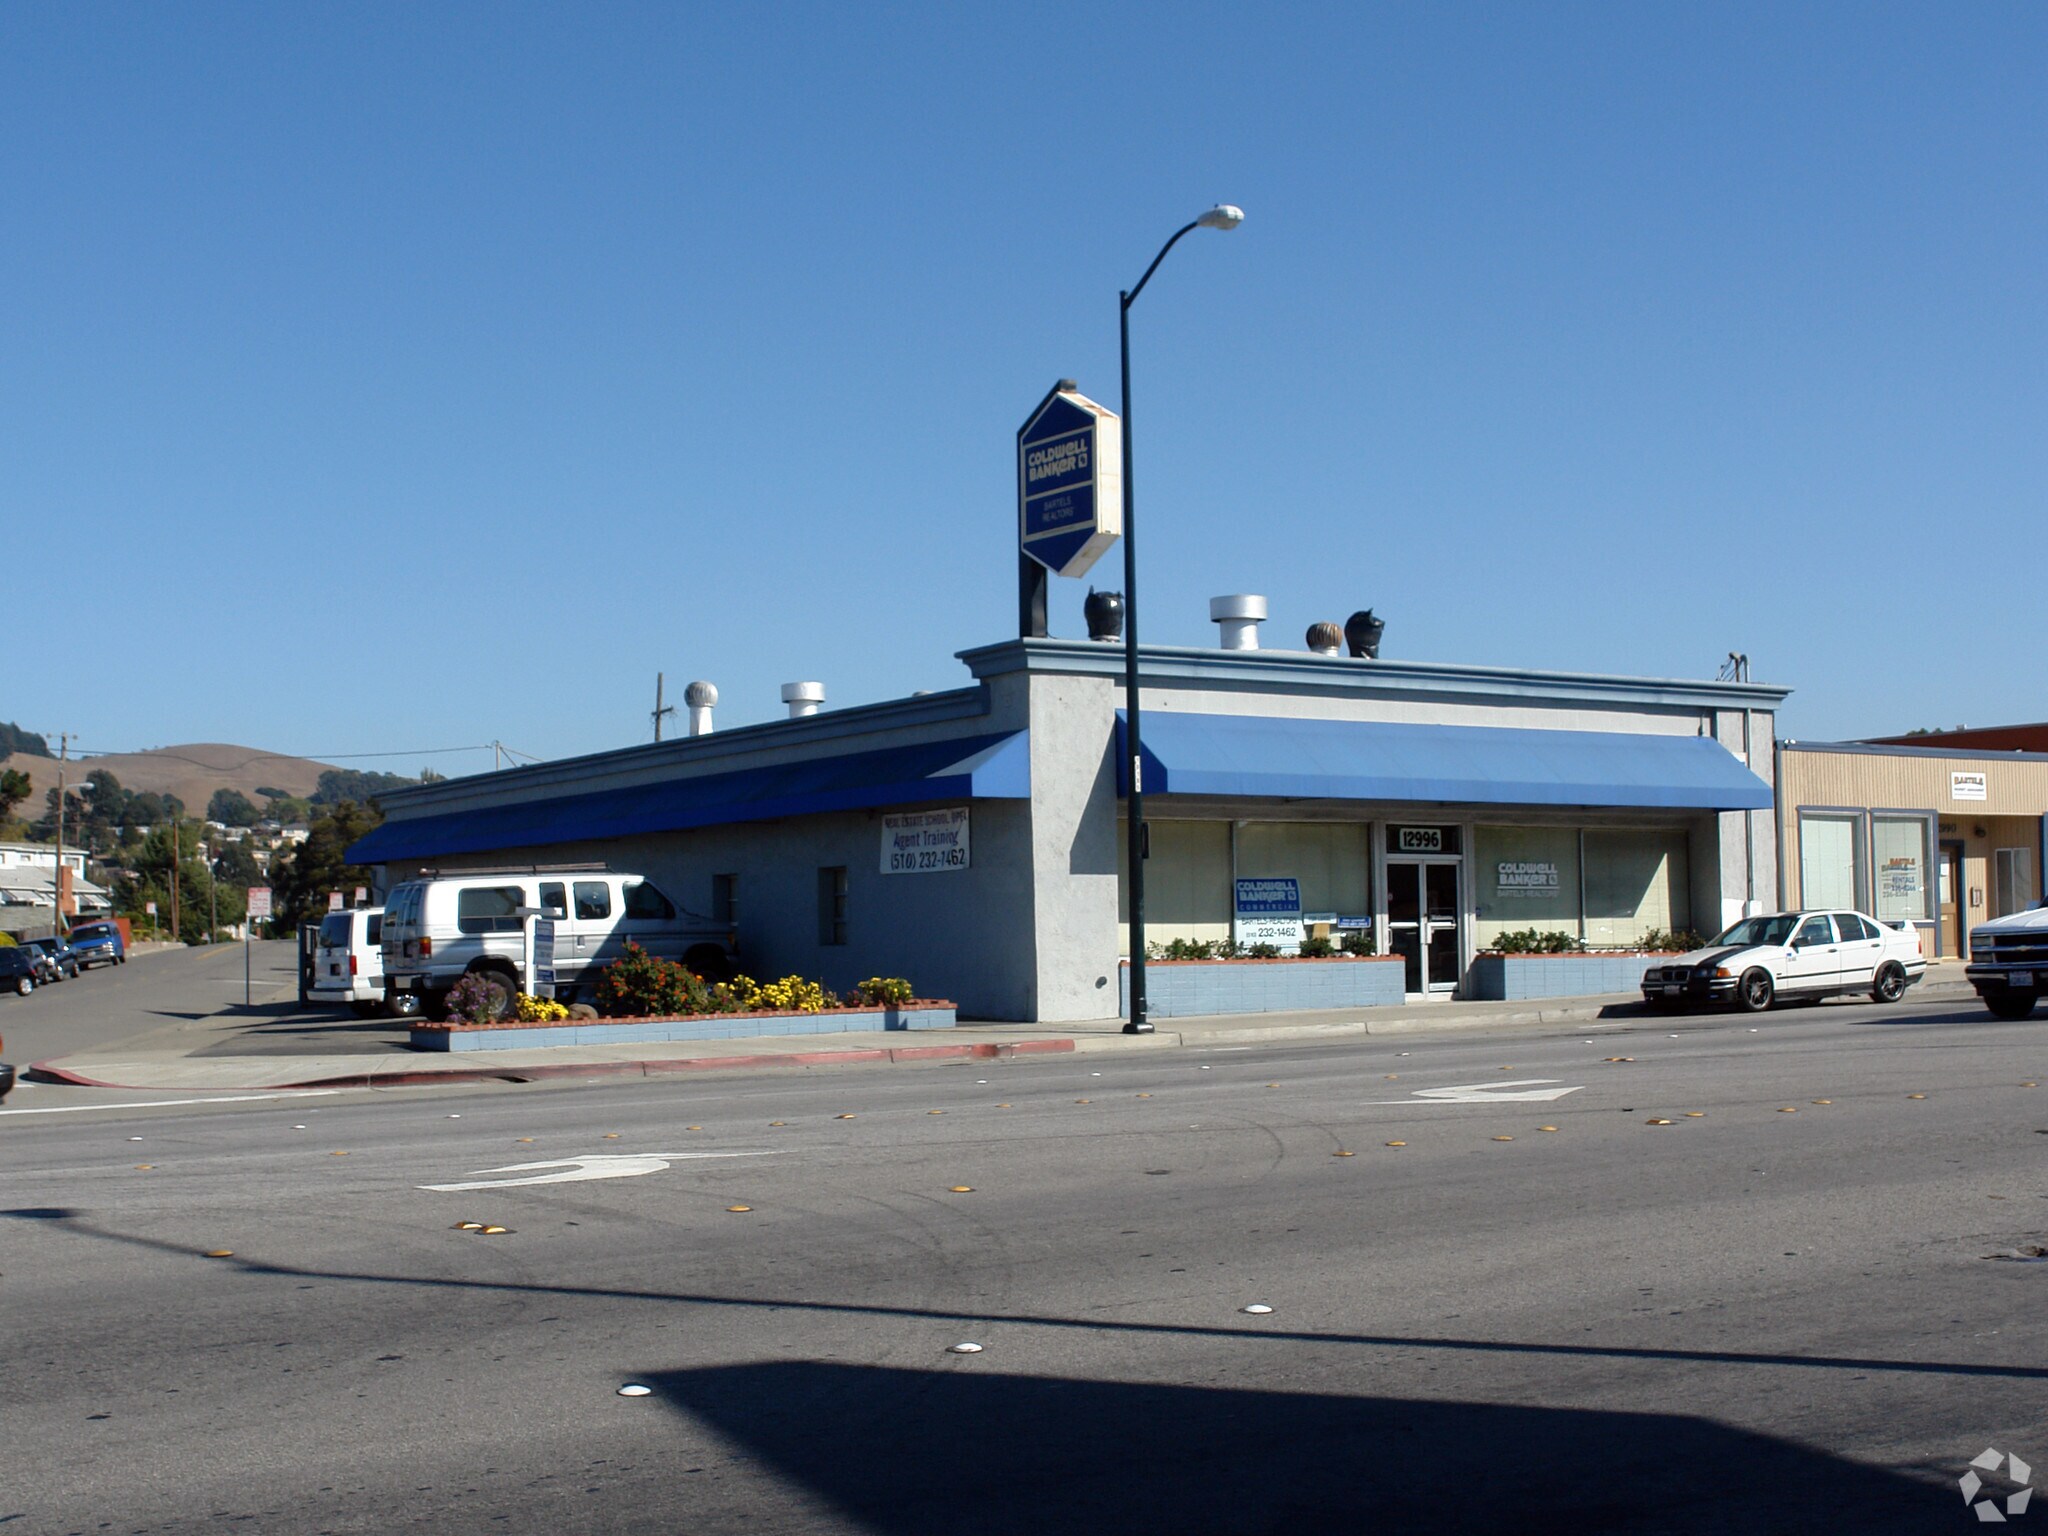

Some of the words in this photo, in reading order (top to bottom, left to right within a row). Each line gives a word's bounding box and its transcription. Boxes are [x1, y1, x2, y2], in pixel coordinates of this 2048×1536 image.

[1029, 456, 1076, 482] BANKER
[902, 815, 924, 827] ESTATE
[925, 813, 950, 826] SCHOOL
[893, 832, 920, 851] Agent
[923, 828, 958, 846] Training
[1403, 830, 1439, 847] 12996
[890, 852, 916, 870] (510)
[919, 848, 965, 868] 232-1462
[1499, 874, 1547, 886] BANKER
[1239, 890, 1286, 902] BANKER
[1239, 903, 1298, 911] COMMERCIAL
[1258, 927, 1297, 938] 232-1462
